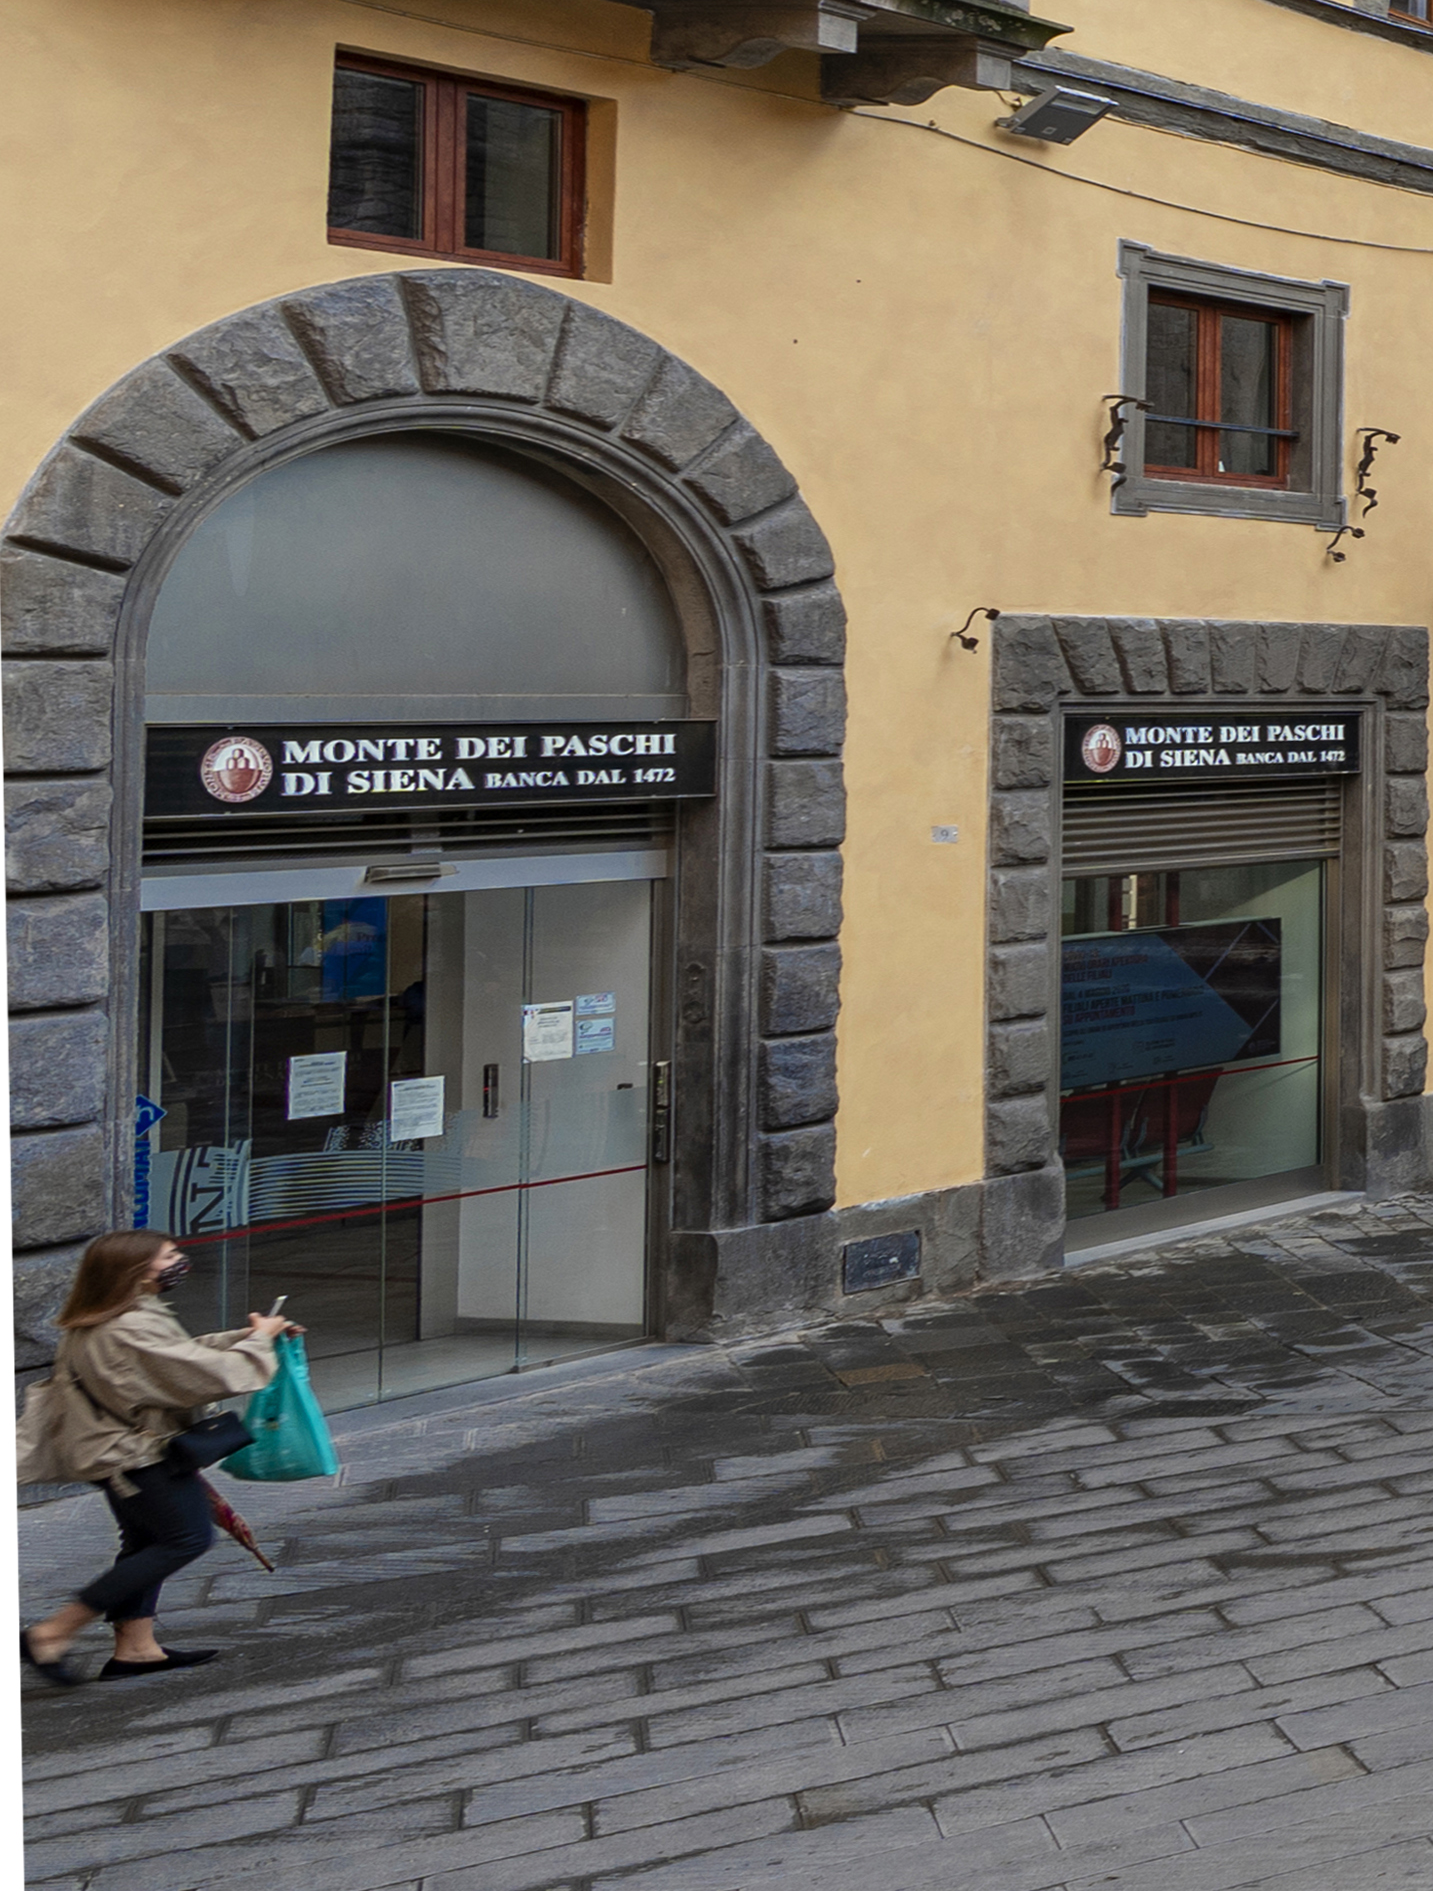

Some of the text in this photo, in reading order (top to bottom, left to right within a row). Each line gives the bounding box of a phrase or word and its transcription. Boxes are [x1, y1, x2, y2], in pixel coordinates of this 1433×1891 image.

[1125, 724, 1345, 745] MONTE DEI PASCHI
[281, 734, 677, 764] MONTE DEI PASCHI
[1124, 748, 1346, 768] DI SIENA BANCA DAL 1472
[280, 767, 676, 796] DI SIENA BANCA DAL 1472
